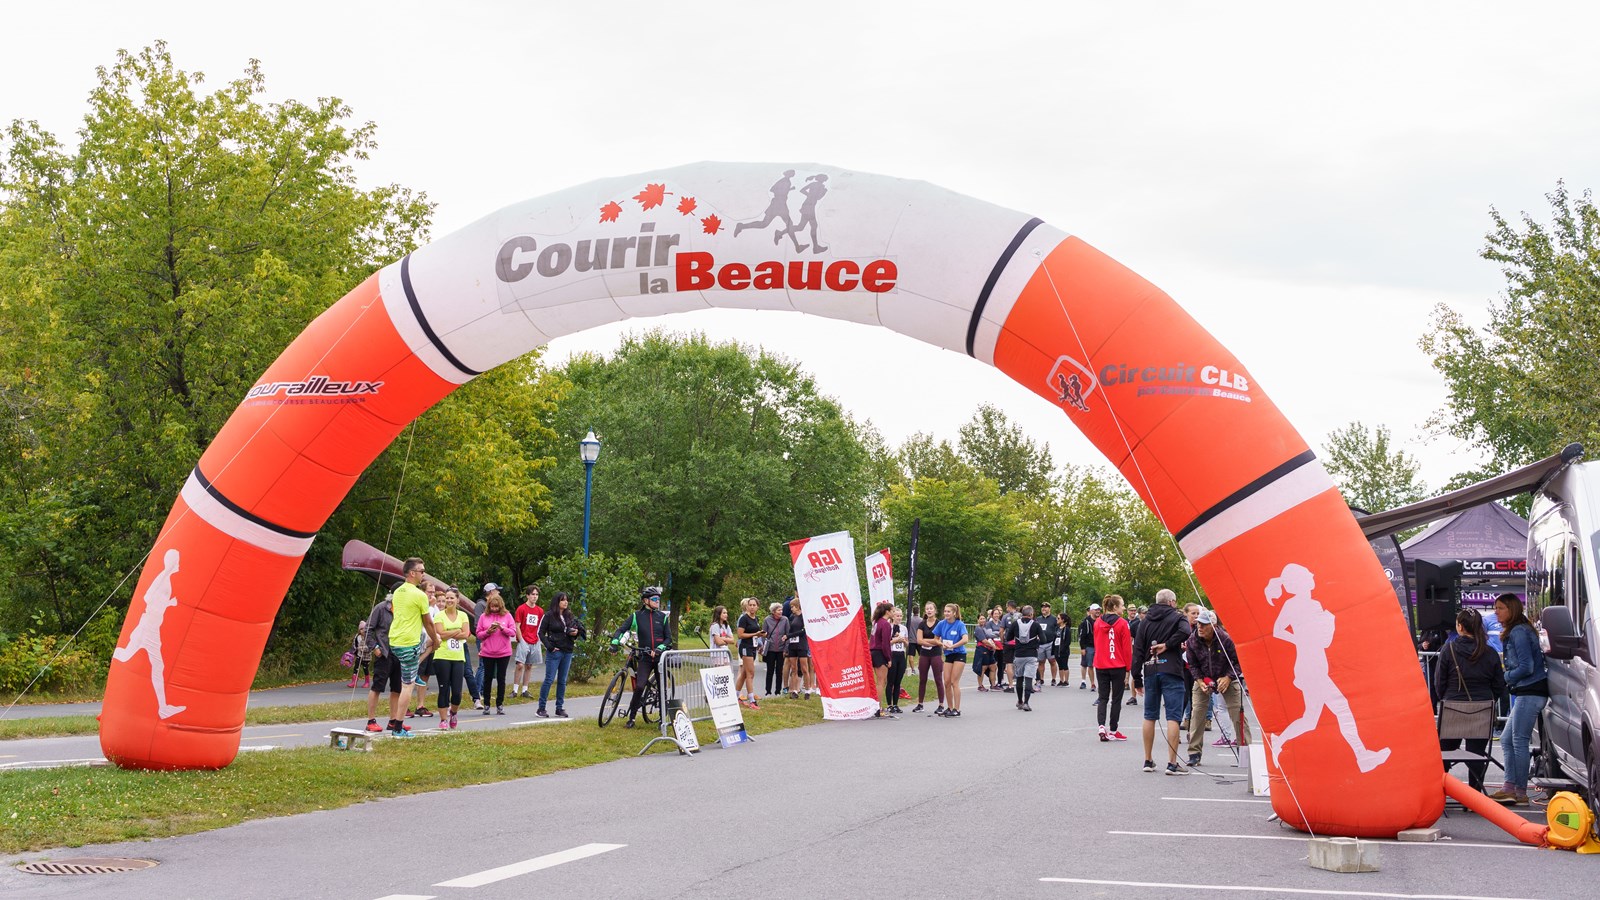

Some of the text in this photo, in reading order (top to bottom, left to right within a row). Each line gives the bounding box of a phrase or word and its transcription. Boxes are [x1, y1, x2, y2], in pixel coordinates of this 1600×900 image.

[495, 222, 680, 283] Courir
[639, 252, 897, 294] la Beauce
[246, 376, 383, 399] ourailleux
[1100, 363, 1249, 391] Circuit CLB
[1212, 388, 1251, 403] Beauce
[529, 616, 536, 624] 82
[450, 639, 460, 649] 68
[1108, 627, 1116, 660] ANADA
[712, 674, 729, 687] Usinage
